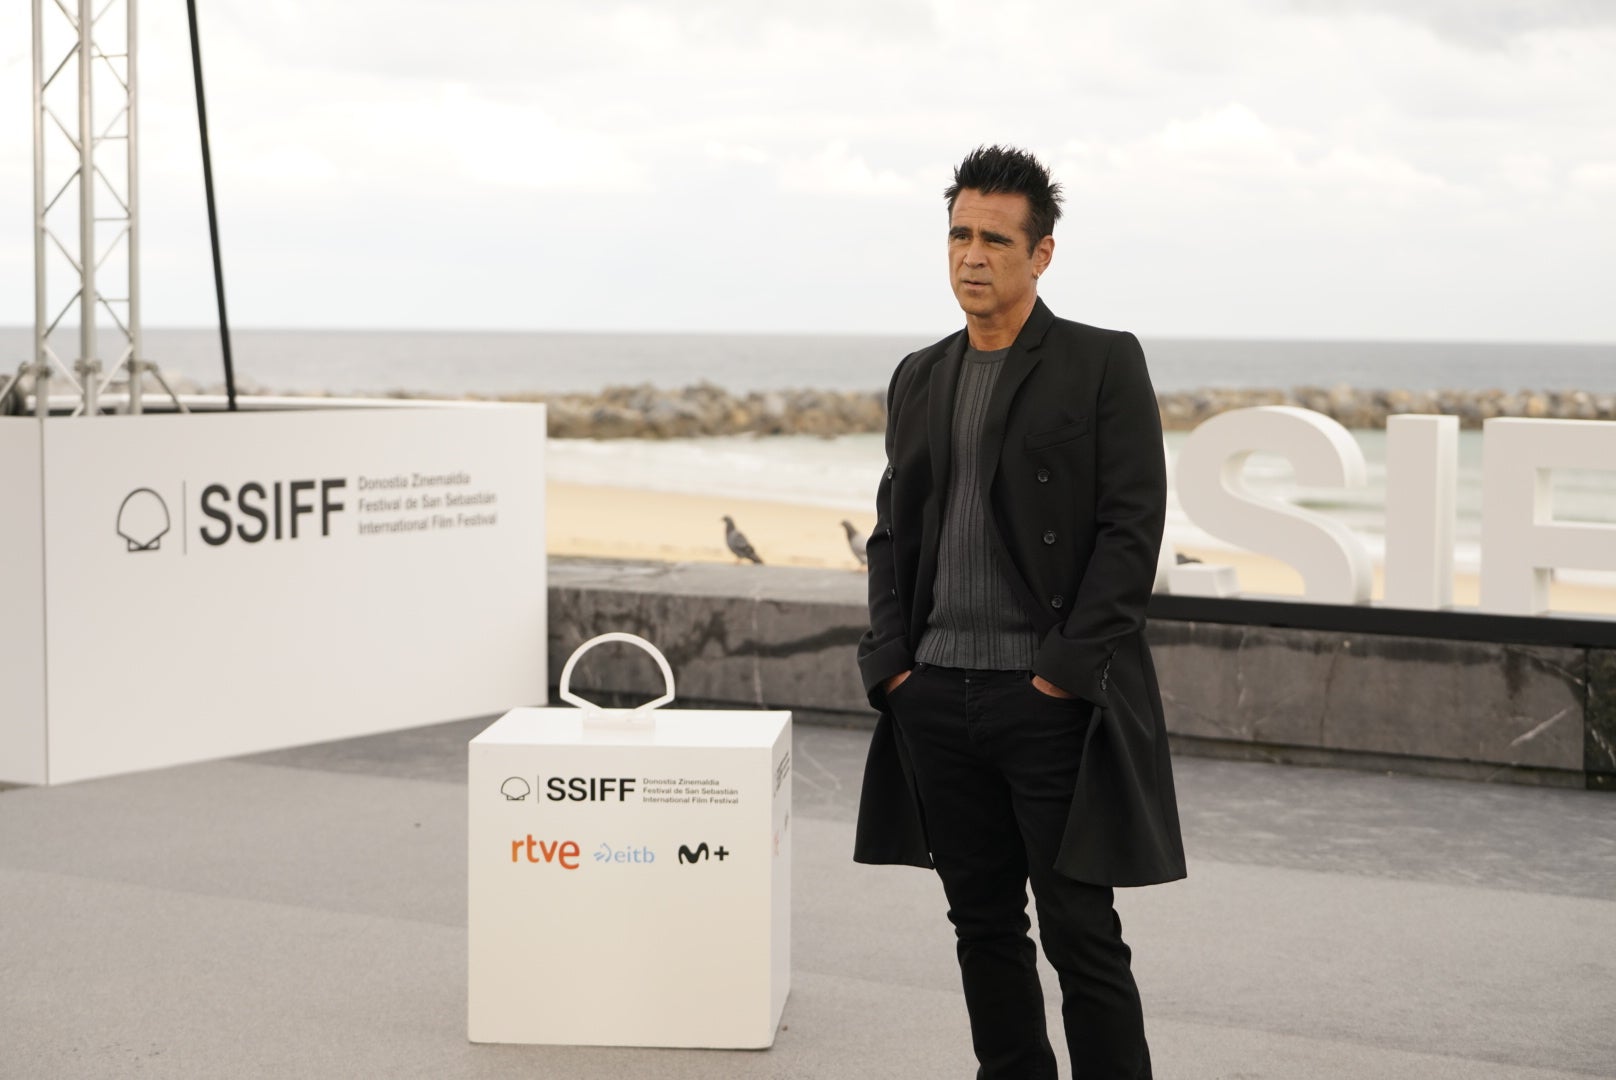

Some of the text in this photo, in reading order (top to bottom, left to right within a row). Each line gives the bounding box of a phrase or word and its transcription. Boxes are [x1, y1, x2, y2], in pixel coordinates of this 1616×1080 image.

[358, 473, 471, 490] Donostia Zinemaldia
[199, 478, 347, 546] SSIFF
[359, 498, 401, 512] Festival
[405, 498, 417, 510] de
[422, 494, 441, 509] San
[1155, 405, 1616, 618] SIF
[359, 513, 497, 535] International Film Festival
[546, 776, 636, 802] SSIFF
[511, 834, 580, 870] rtve
[614, 846, 655, 863] eitb
